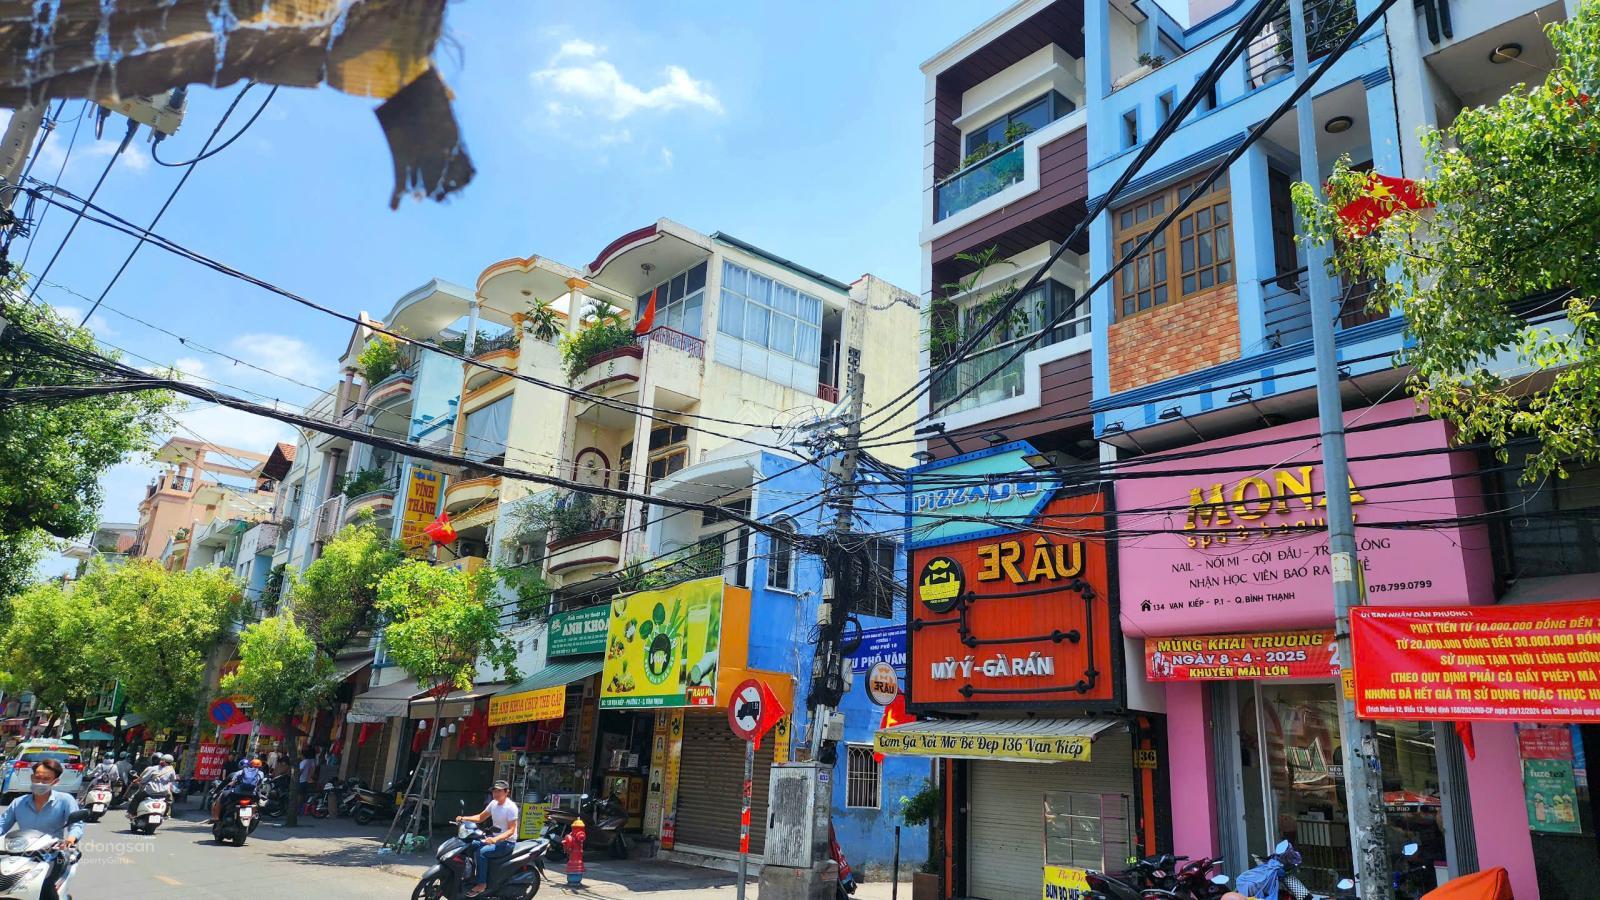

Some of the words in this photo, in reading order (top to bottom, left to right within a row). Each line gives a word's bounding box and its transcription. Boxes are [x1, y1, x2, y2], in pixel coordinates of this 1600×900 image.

[408, 498, 435, 515] THÀNH
[1355, 537, 1391, 552] LÔNG
[1172, 562, 1194, 573] NAIL
[1205, 554, 1225, 569] NỐI
[1227, 556, 1240, 567] MI
[1252, 552, 1272, 564] GỘI
[1278, 547, 1302, 561] ĐẦU
[1189, 576, 1219, 589] NHẬN
[1223, 573, 1247, 588] HỌC
[1252, 569, 1278, 582] VIÊN
[1283, 567, 1308, 579] BAO
[1313, 565, 1330, 576] RA
[1369, 580, 1433, 593] 078.799.0799
[1188, 597, 1205, 609] KIẾP
[1213, 598, 1224, 606] P.1
[1267, 592, 1296, 603] THẠNH
[562, 621, 583, 636] ANH
[1410, 623, 1433, 636] PHẠT
[1460, 621, 1473, 632] TỪ
[1476, 621, 1533, 632] 10.000.000
[1535, 617, 1567, 630] ĐỒNG
[1569, 615, 1593, 629] ĐẾN
[1207, 636, 1246, 650] KHAI
[1396, 637, 1409, 650] TỪ
[1410, 639, 1462, 650] 20.000.000
[1463, 635, 1490, 649] ĐỒNG
[1491, 633, 1513, 648] ĐẾN
[1515, 634, 1574, 648] 30.000.000
[983, 653, 1011, 678] GÀ
[1012, 651, 1055, 677] RÁN
[1172, 652, 1215, 666] NGÀY
[1219, 654, 1229, 664] 8
[1242, 653, 1253, 664] 4
[1264, 650, 1307, 663] 2025
[1457, 654, 1486, 668] DỤNG
[1486, 655, 1509, 668] TẠM
[1510, 651, 1536, 666] THỜI
[1536, 651, 1567, 665] LÒNG
[1567, 649, 1600, 663] ĐƯỜN
[1391, 672, 1419, 684] (THEO
[1421, 672, 1440, 684] QUY
[1443, 672, 1467, 685] ĐỊNH
[1469, 668, 1495, 683] PHẢI
[1515, 668, 1540, 683] GIẤY
[1577, 668, 1598, 682] MÀ
[1398, 687, 1413, 700] ĐÃ
[1414, 686, 1433, 700] HẾT
[1435, 687, 1453, 700] GIÁ
[1455, 689, 1472, 702] TRỊ
[1490, 689, 1521, 702] DỤNG
[1522, 687, 1554, 702] HOẶC
[1556, 688, 1586, 702] THỰC
[879, 735, 900, 748] Cơm
[976, 736, 999, 754] Đẹp
[1002, 737, 1023, 752] 136
[1026, 738, 1051, 755] Vạn
[1055, 738, 1084, 759] Kiếp
